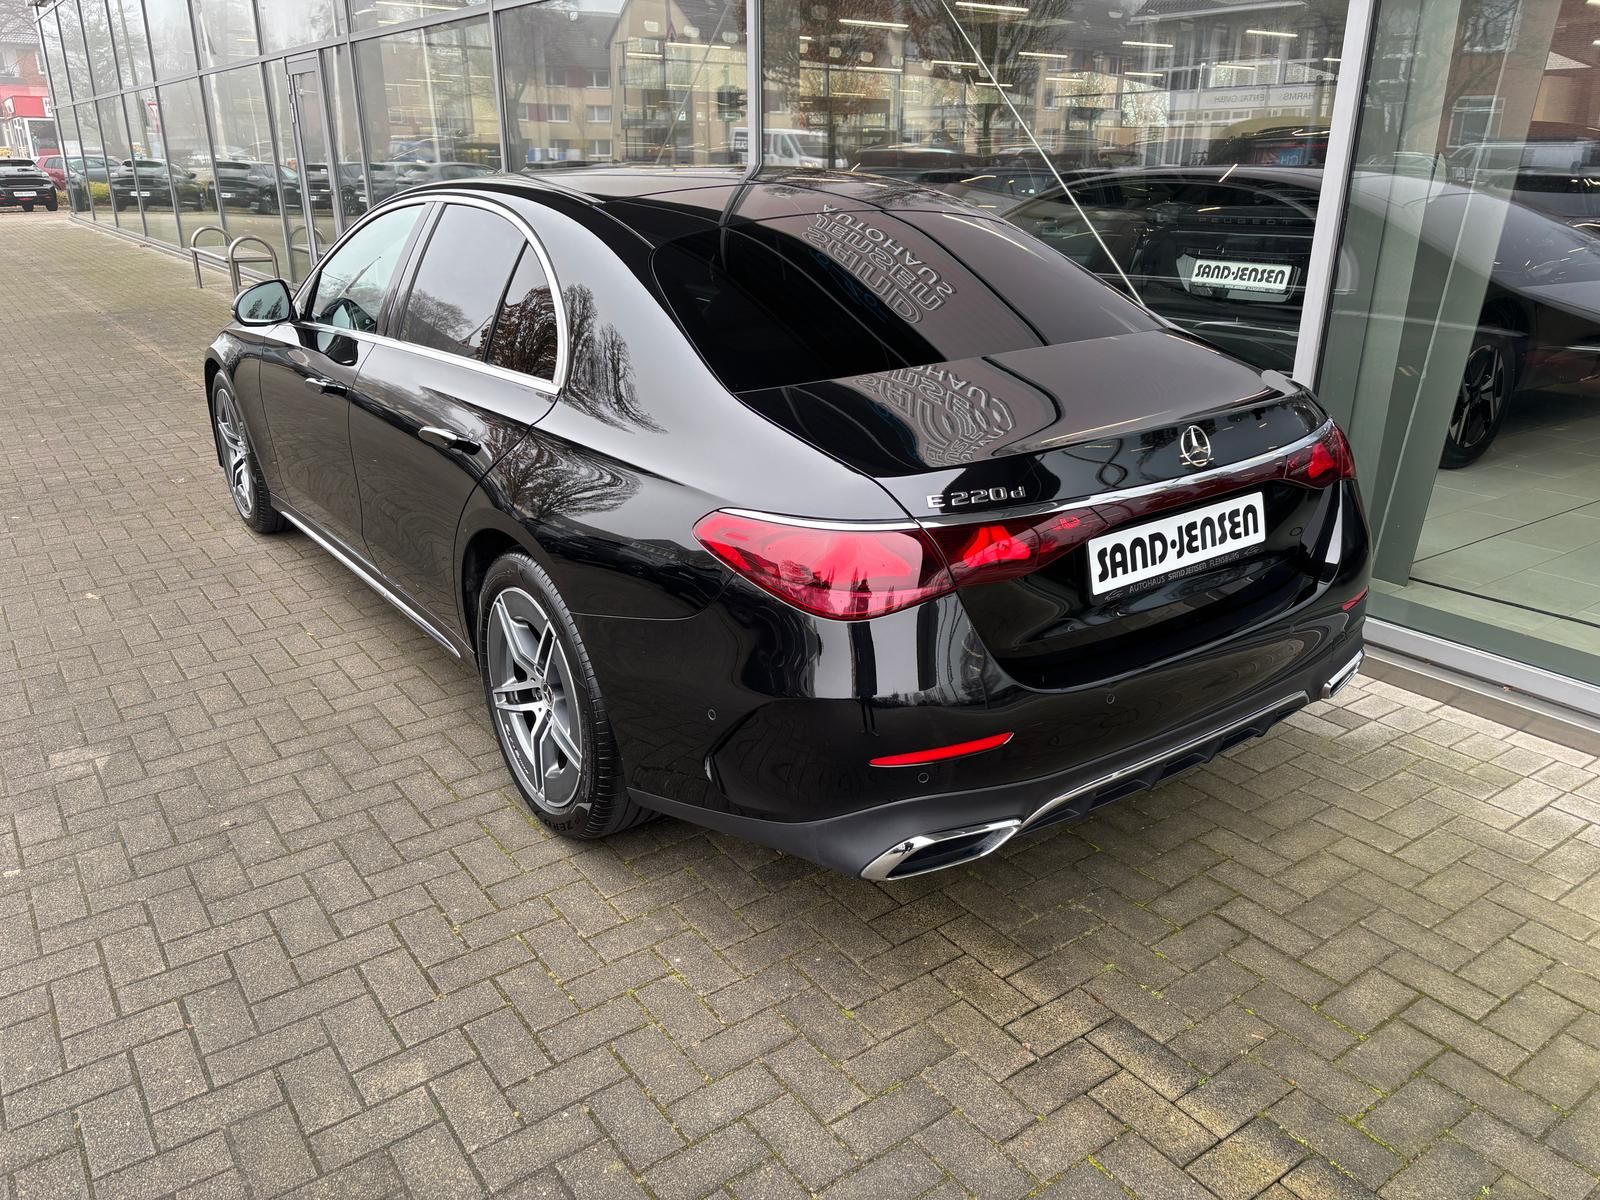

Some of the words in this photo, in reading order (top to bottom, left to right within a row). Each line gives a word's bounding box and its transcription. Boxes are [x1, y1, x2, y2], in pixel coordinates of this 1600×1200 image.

[926, 494, 946, 509] E
[1129, 575, 1165, 593] AUTOHAUS
[1209, 552, 1240, 567] FLENSBURG
